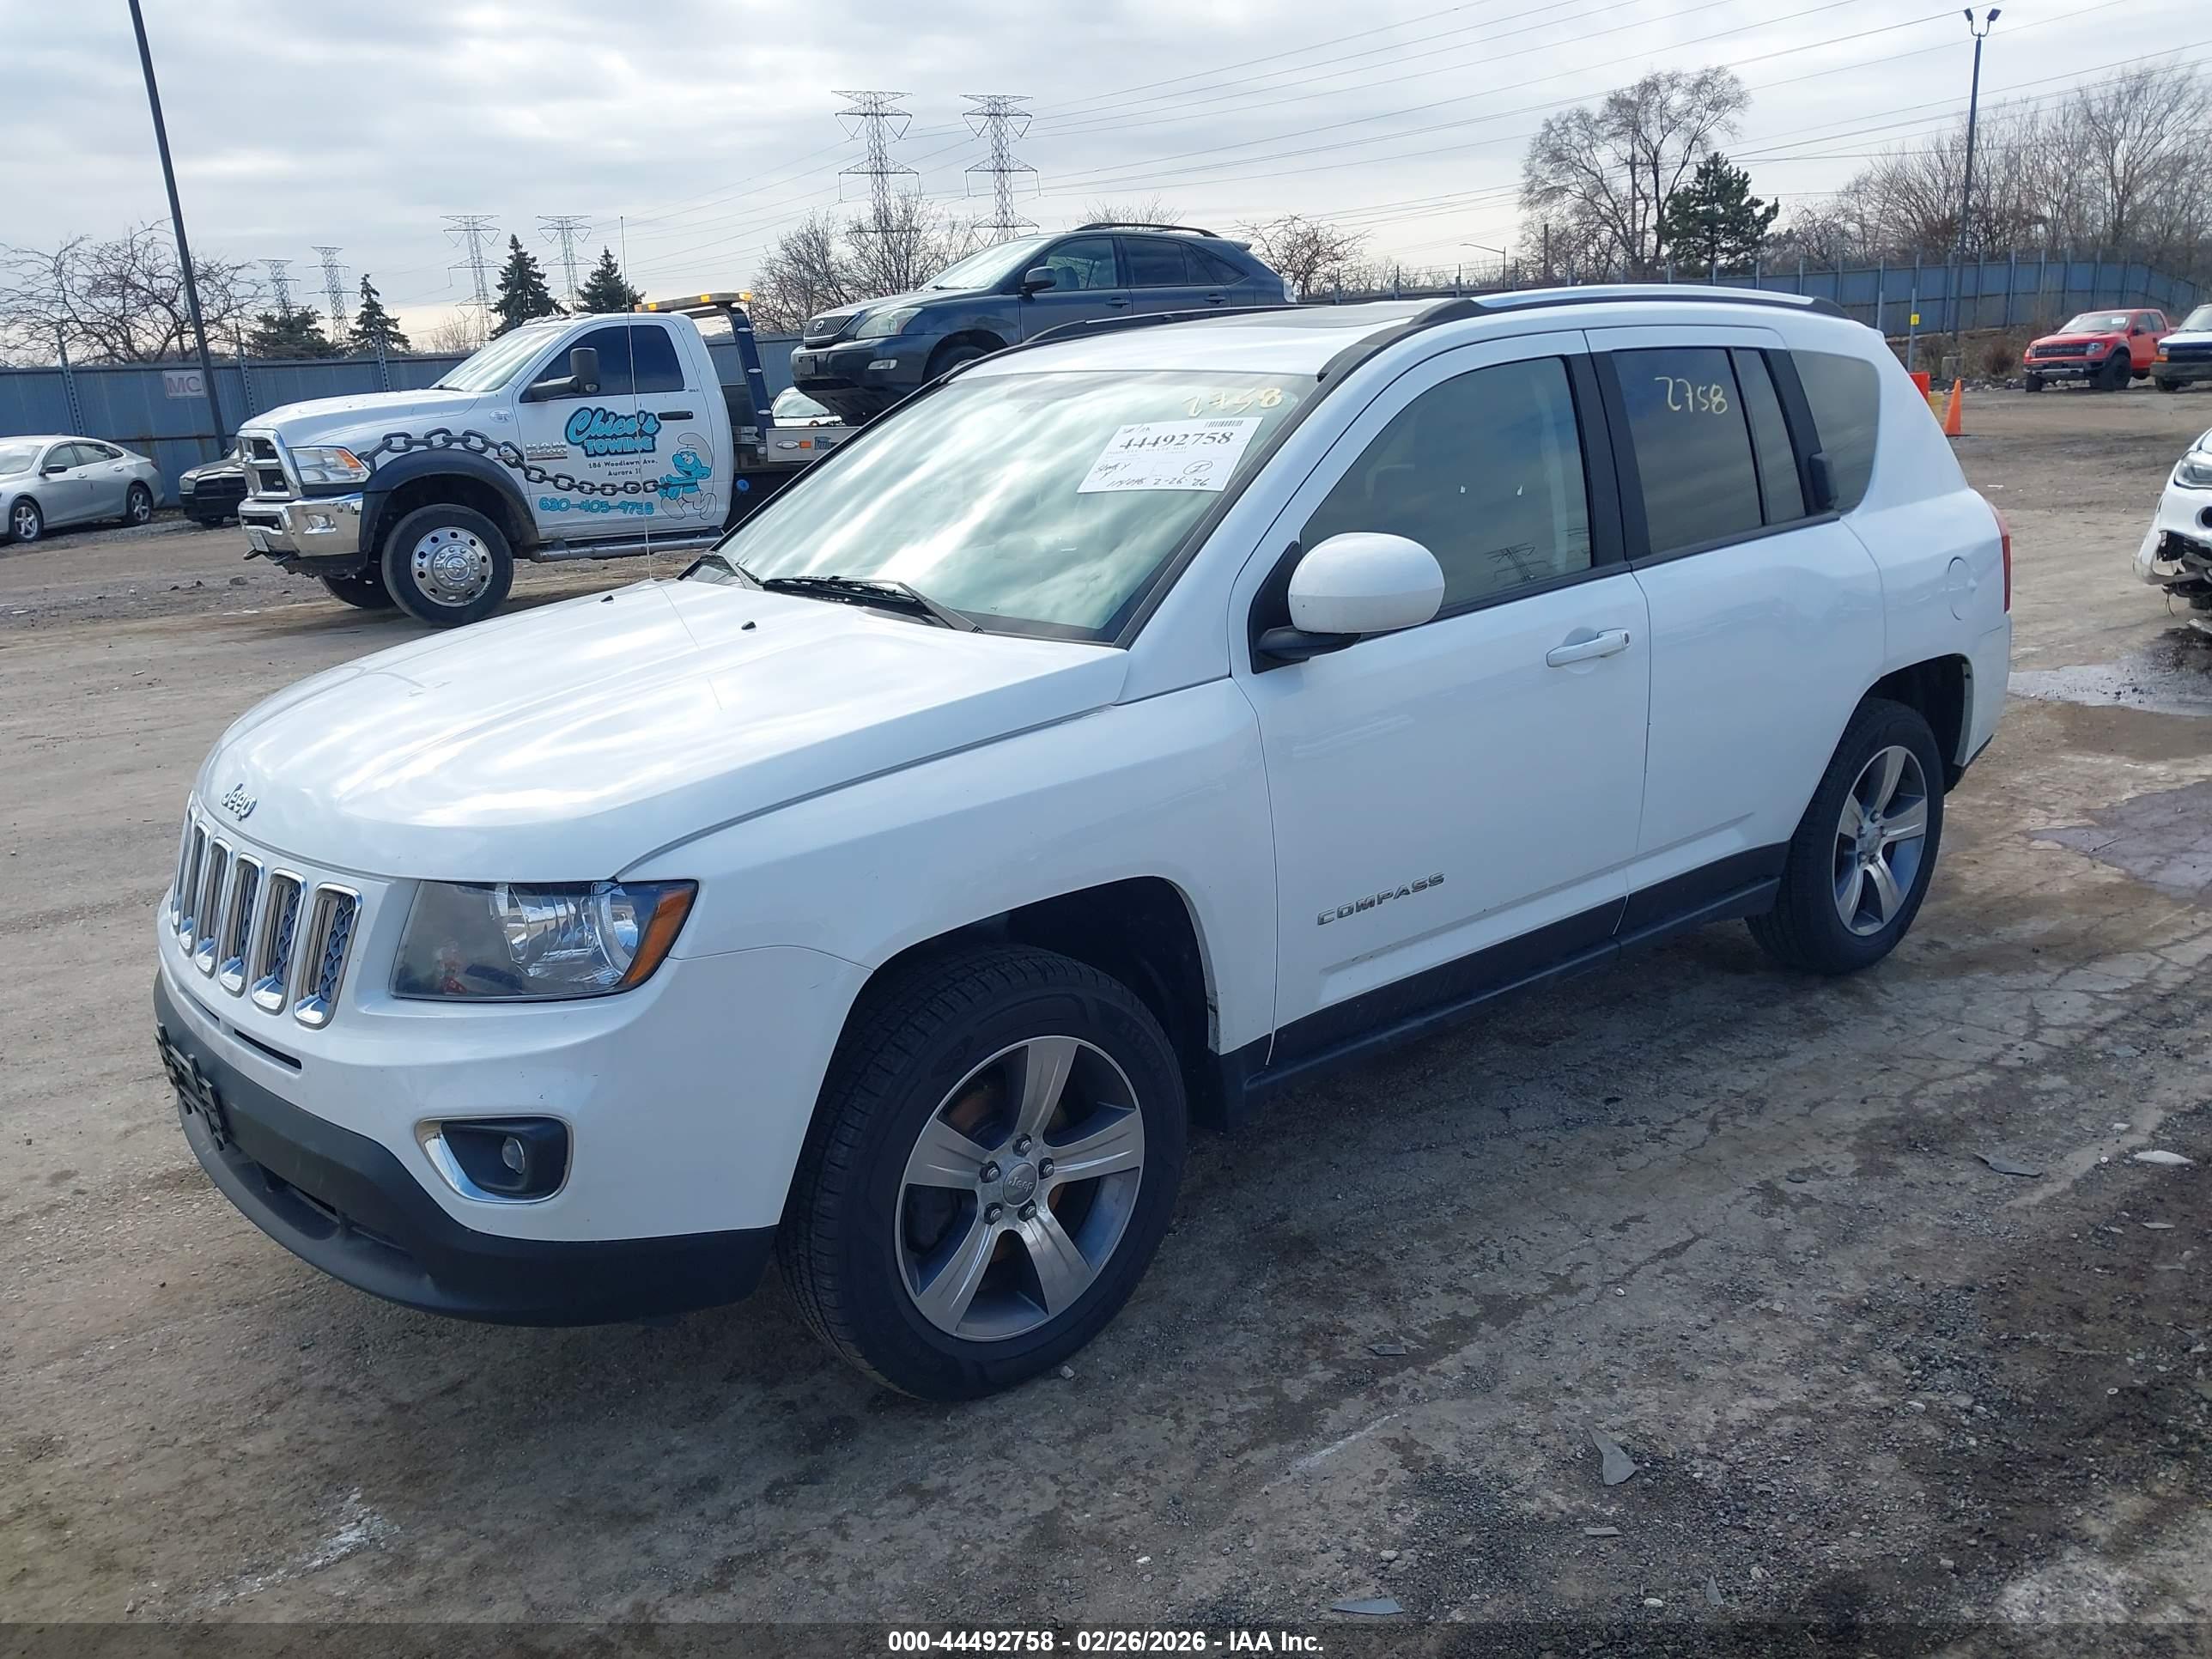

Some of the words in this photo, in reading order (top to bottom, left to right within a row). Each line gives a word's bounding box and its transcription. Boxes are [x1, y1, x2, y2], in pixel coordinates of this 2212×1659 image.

[1654, 376, 1728, 415] 2758
[566, 408, 660, 444] Chico's
[1119, 431, 1234, 449] 44492758
[585, 435, 654, 455] TOWING
[538, 497, 654, 515] 630-405-9758
[221, 782, 258, 822] Jeep
[1316, 871, 1445, 926] COMPASS
[1008, 1176, 1034, 1193] Jeep
